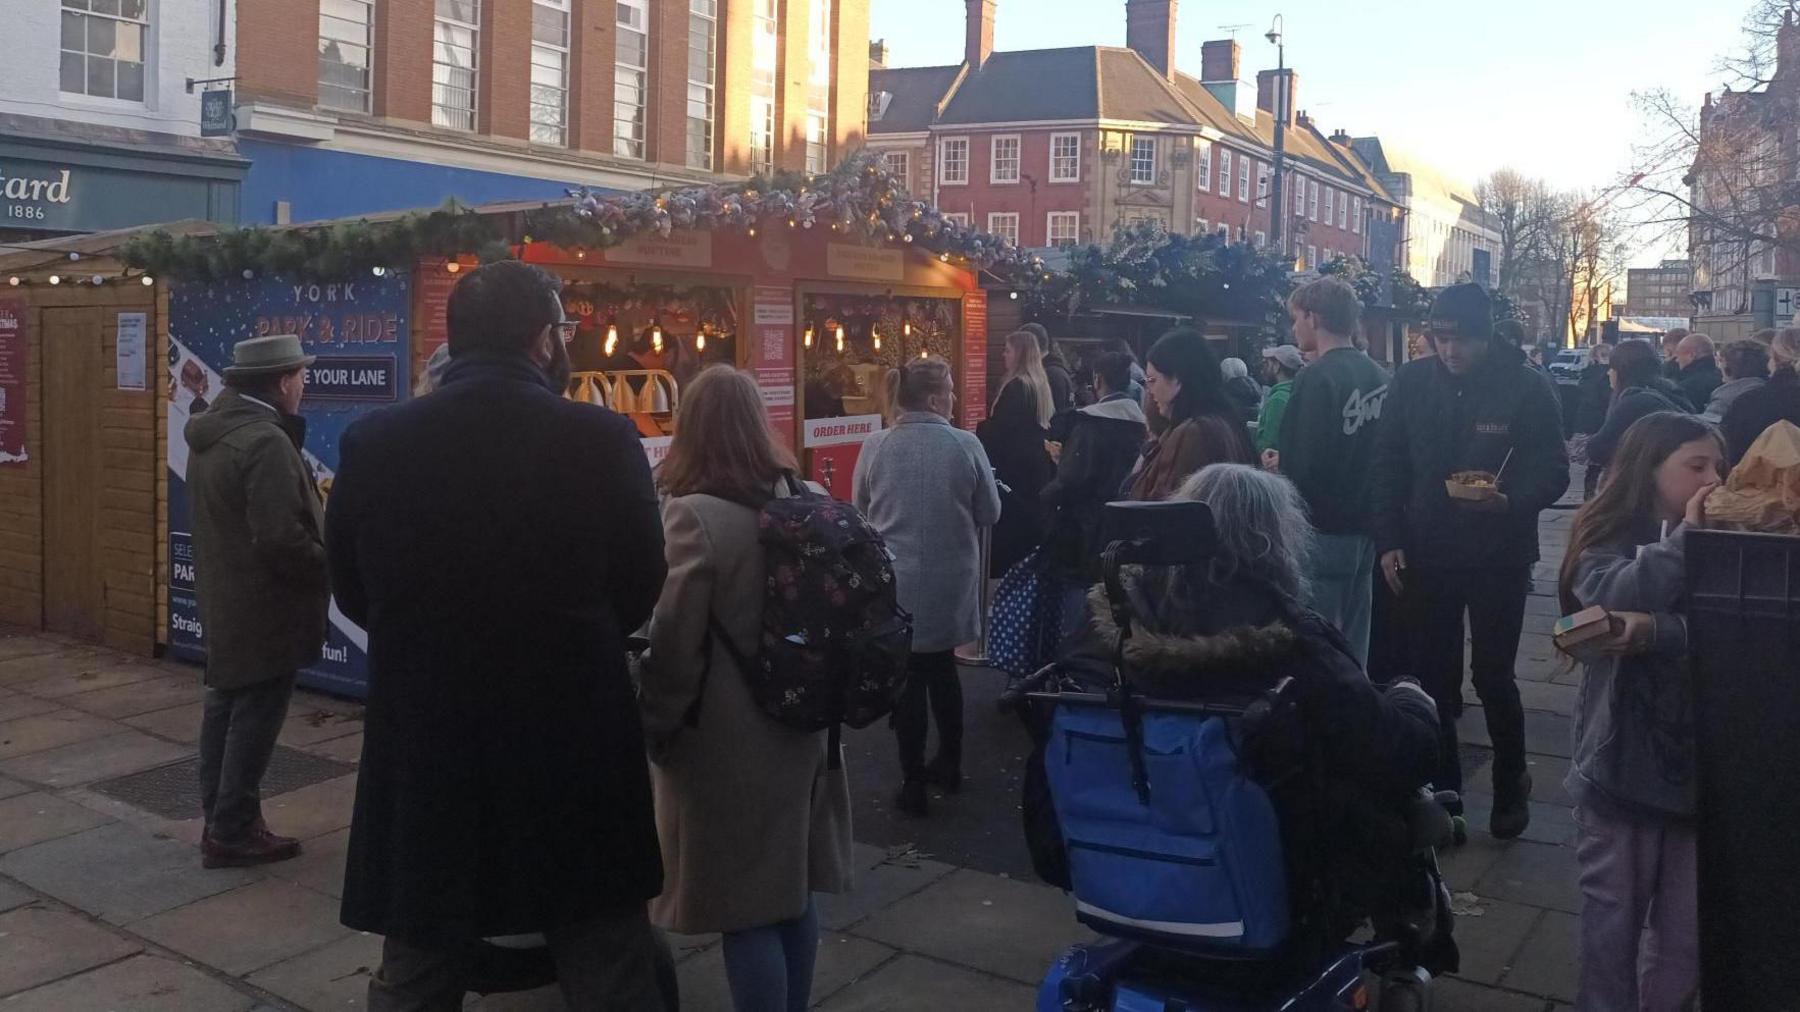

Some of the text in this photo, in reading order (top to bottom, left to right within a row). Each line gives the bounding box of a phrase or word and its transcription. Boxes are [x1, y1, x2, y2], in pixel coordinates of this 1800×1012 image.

[8, 205, 45, 220] 1886
[293, 283, 355, 302] YORK
[320, 315, 335, 344] &
[343, 313, 398, 344] RIDE
[313, 369, 351, 385] YOUR
[351, 369, 386, 386] LANE
[813, 422, 872, 438] ORDER HERE
[174, 543, 193, 557] SELE
[174, 563, 195, 582] PAR
[172, 612, 203, 638] Straig
[321, 640, 348, 663] fun!
